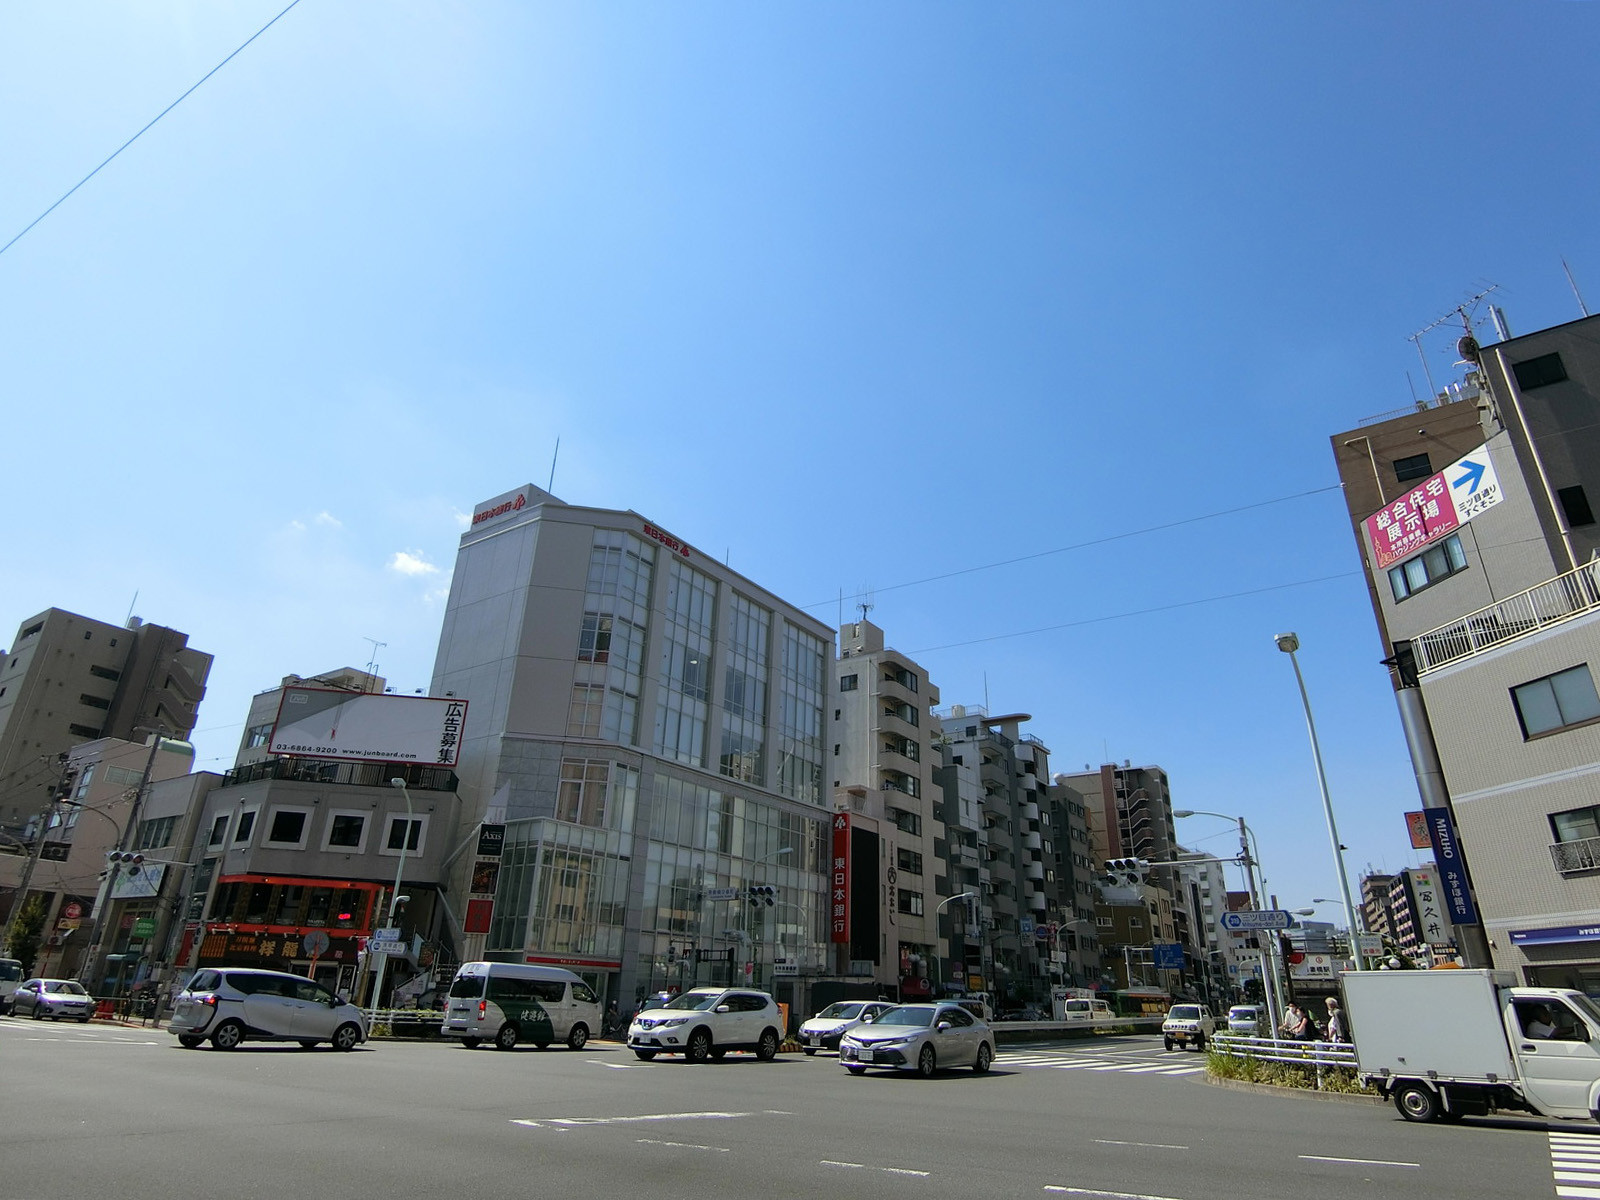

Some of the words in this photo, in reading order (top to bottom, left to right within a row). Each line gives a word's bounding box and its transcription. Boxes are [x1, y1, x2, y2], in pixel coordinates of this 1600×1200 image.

[1375, 477, 1444, 531] 総合住宅
[1458, 484, 1496, 512] 三ツ目通り
[1464, 496, 1496, 517] すぐそこ
[1386, 499, 1440, 543] 展示場
[276, 743, 338, 754] 03-6864-9200
[342, 748, 417, 760] www.junboard.com
[437, 702, 463, 764] 広告募集
[1435, 818, 1454, 859] MIZUHO
[834, 857, 846, 933] 東日本銀行
[1447, 871, 1467, 915] みずほ銀行
[1242, 911, 1284, 921] 三ツ目通り
